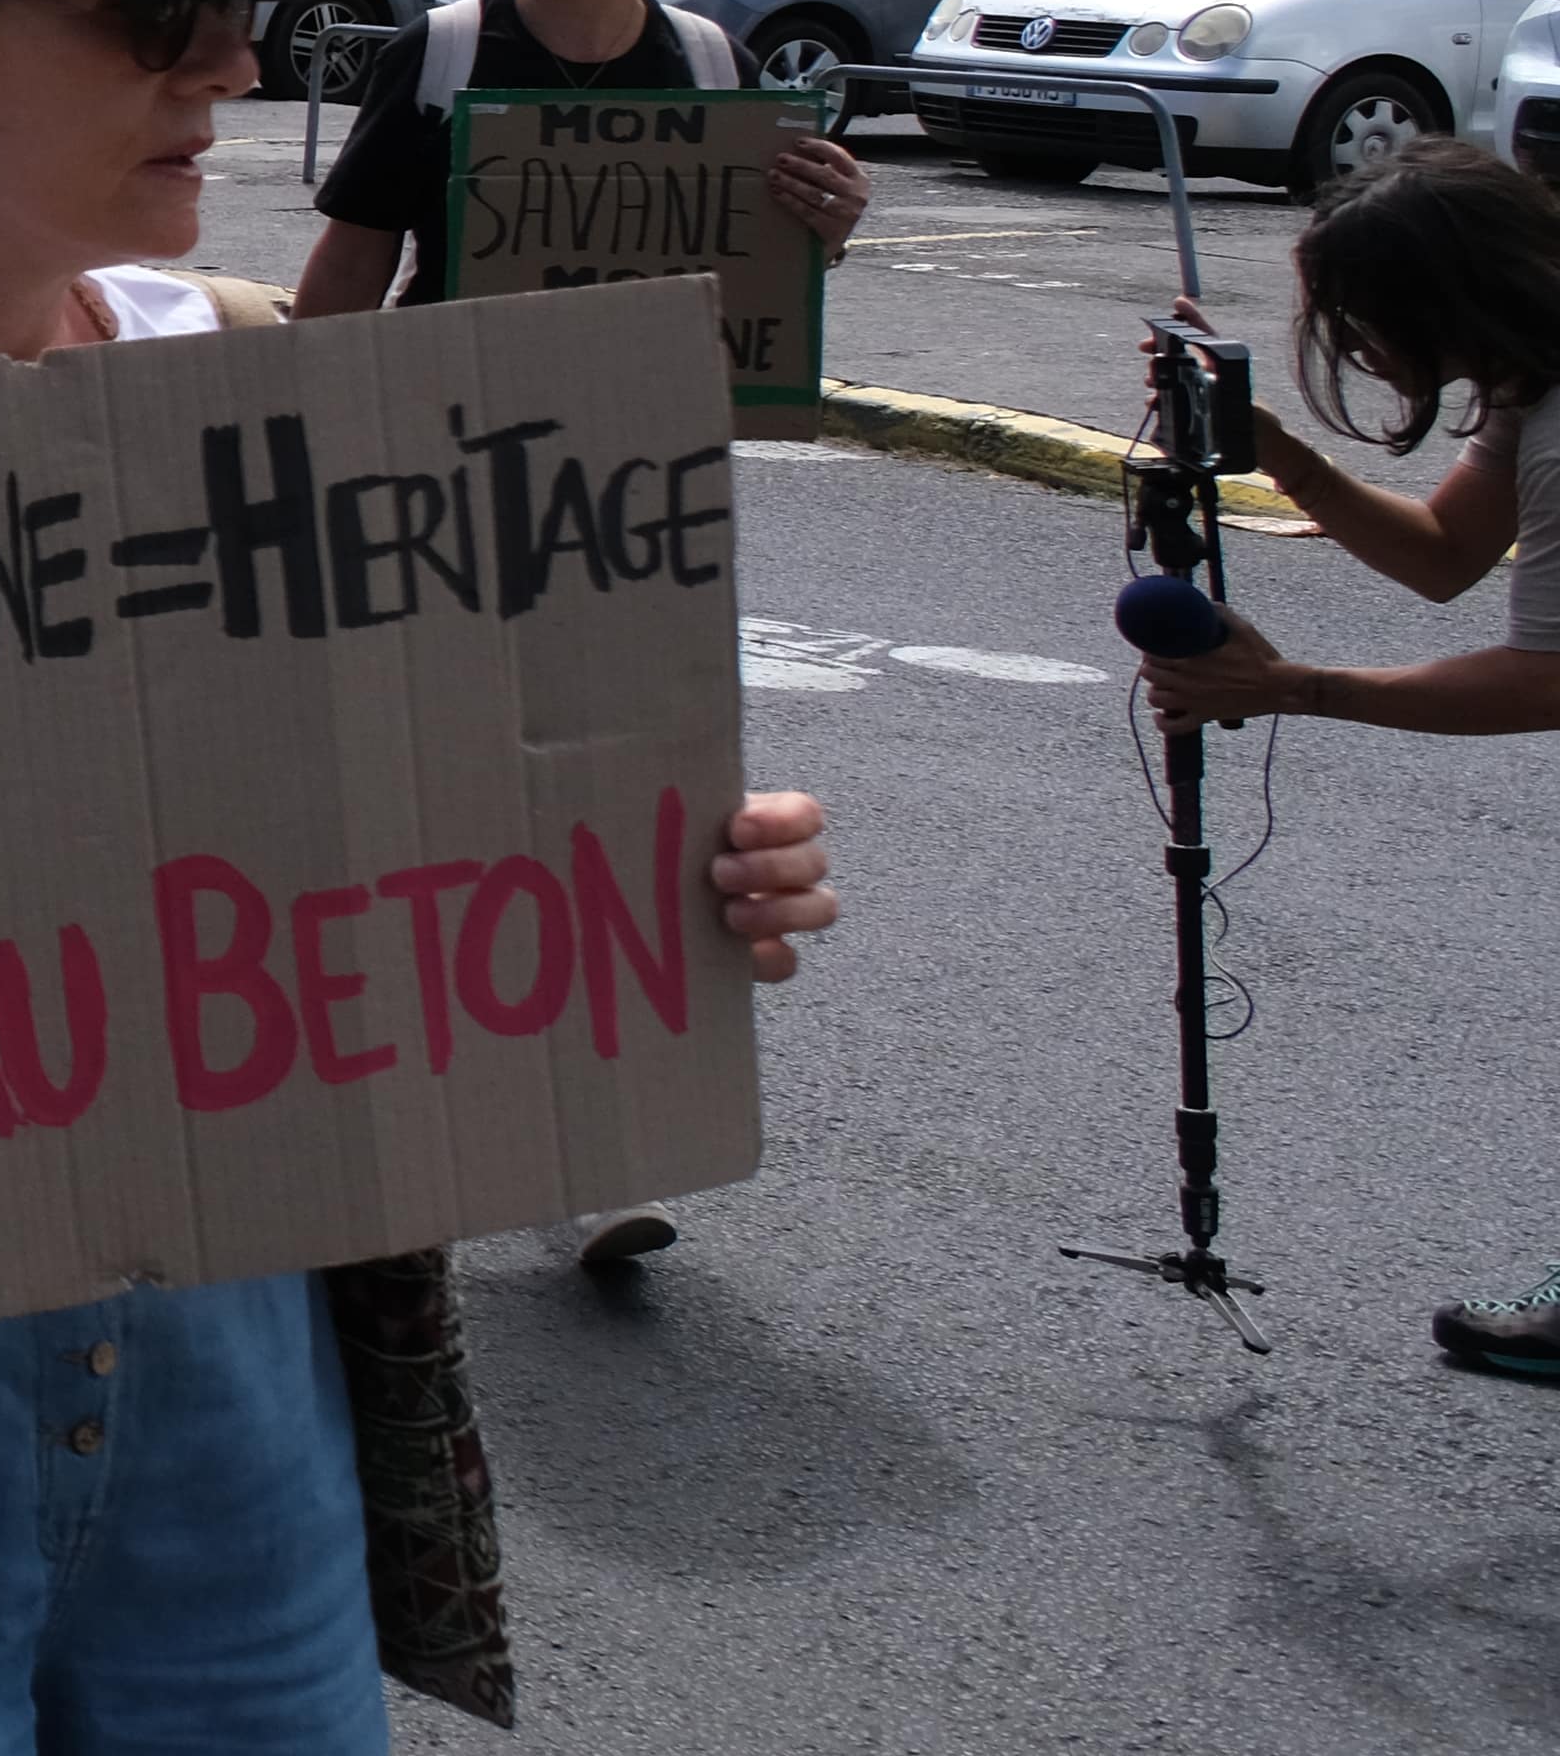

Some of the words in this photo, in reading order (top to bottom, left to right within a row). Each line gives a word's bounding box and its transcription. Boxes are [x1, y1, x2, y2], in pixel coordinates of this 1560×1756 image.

[540, 104, 706, 147] MON
[469, 155, 762, 261] SAVANE
[152, 784, 690, 1113] BETON
